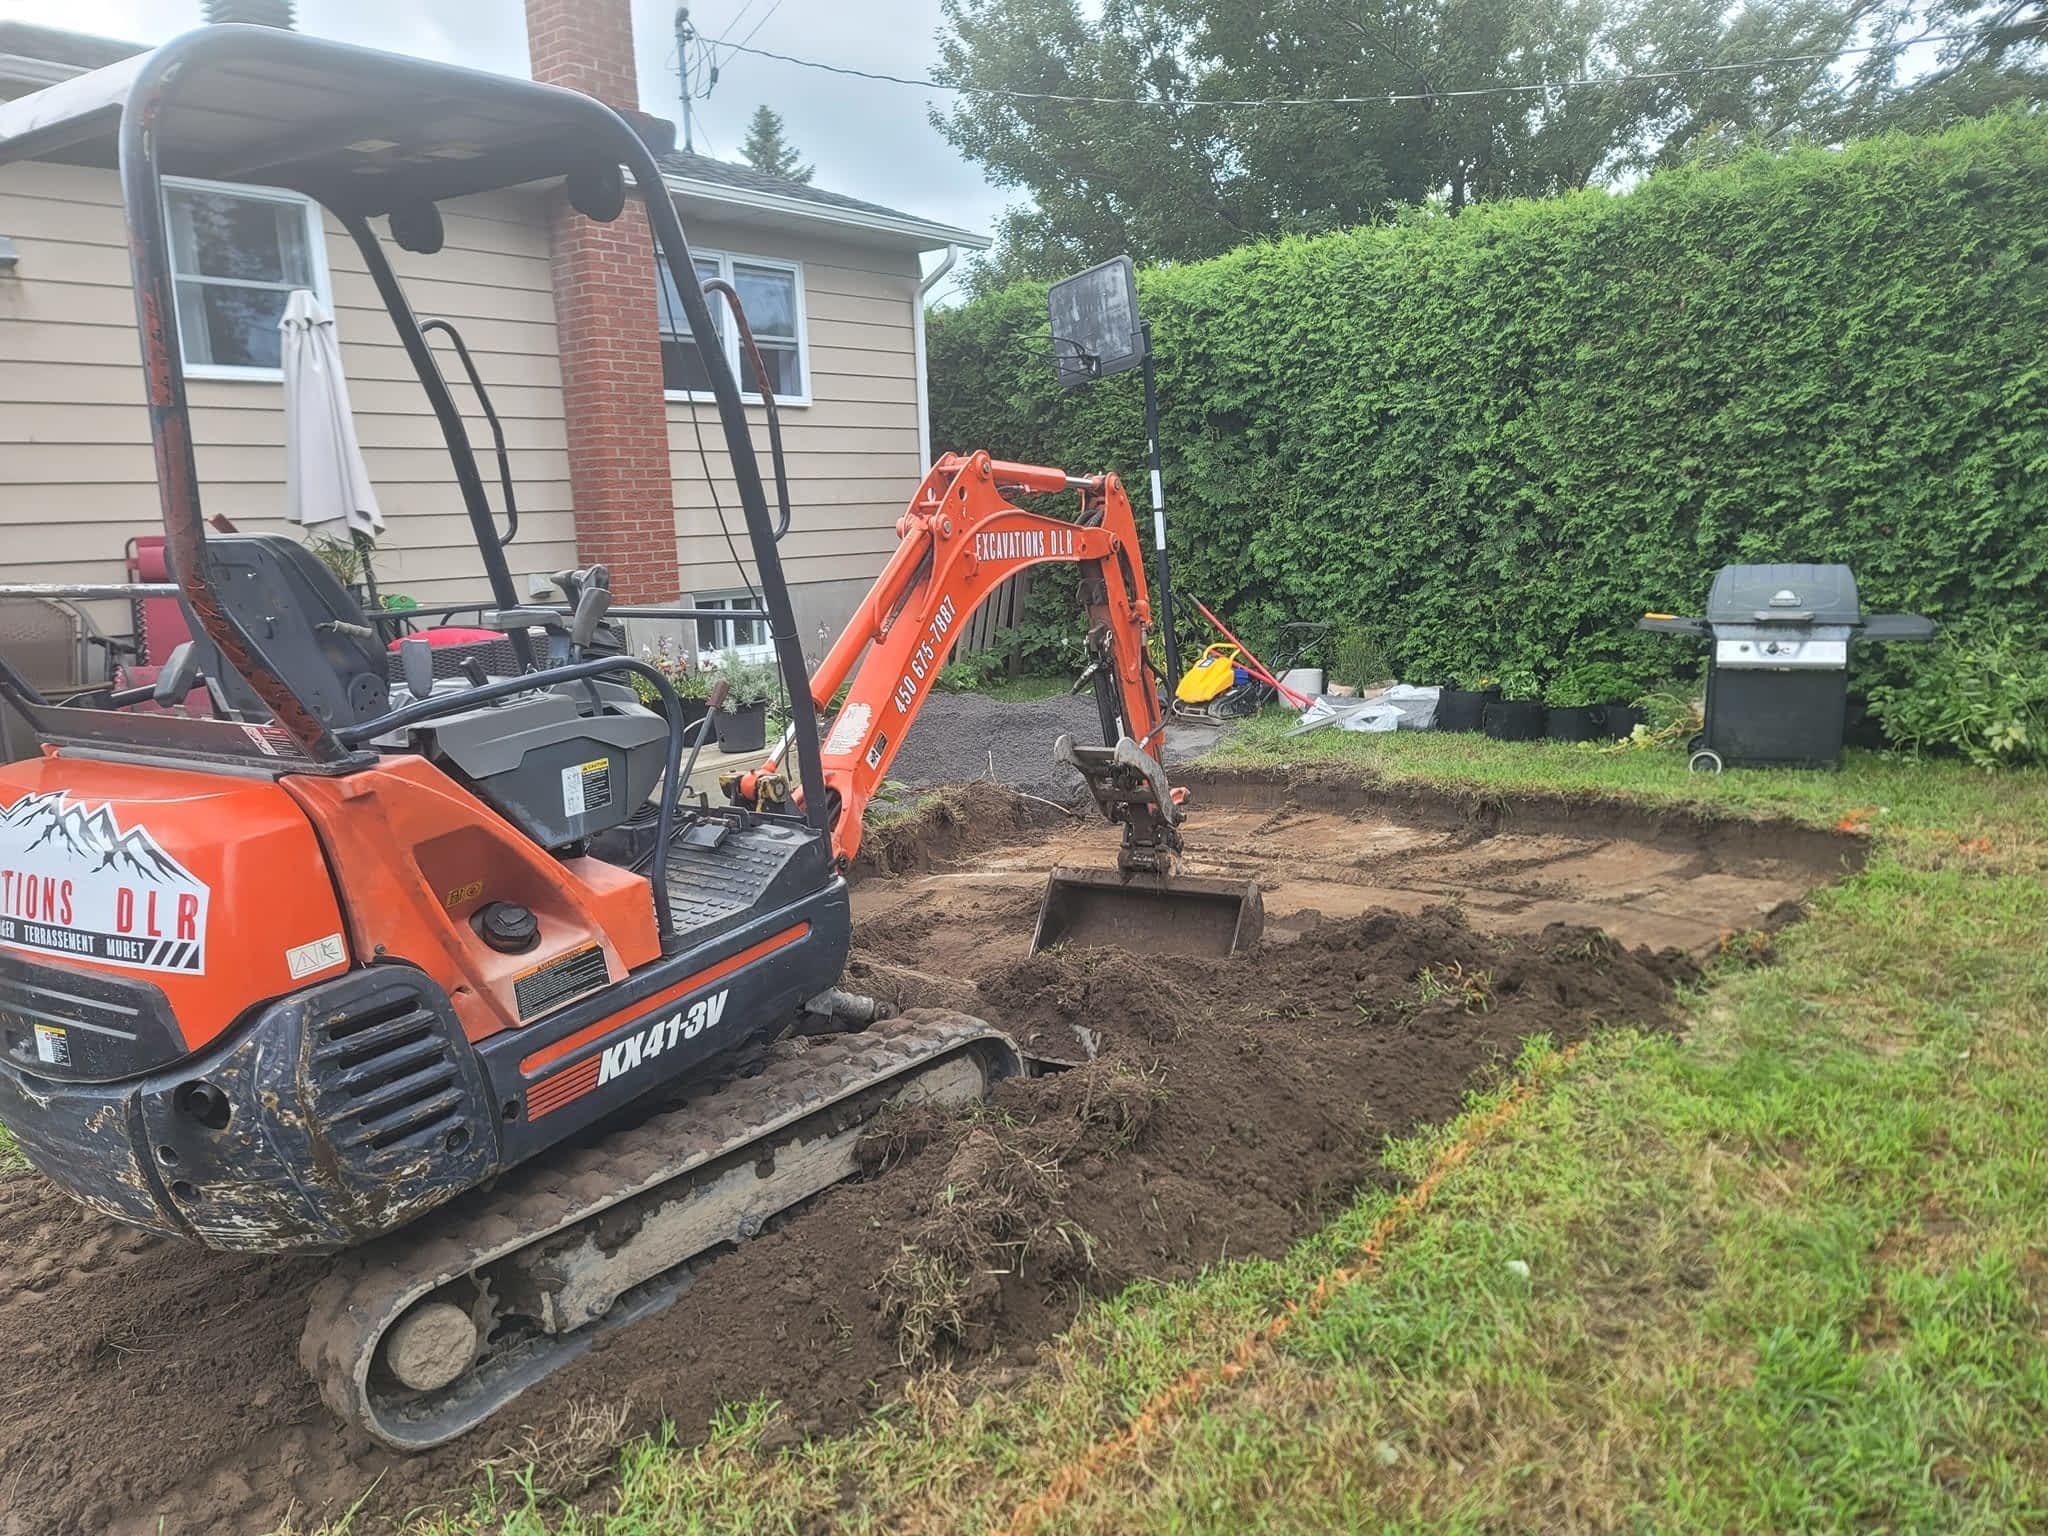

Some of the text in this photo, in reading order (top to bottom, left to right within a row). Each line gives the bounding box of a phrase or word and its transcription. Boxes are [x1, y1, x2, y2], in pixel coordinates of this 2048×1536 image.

[975, 529, 1073, 561] EXCAVATIONS DLR
[894, 594, 956, 713] 450 675-7887
[0, 869, 199, 941] TIONS DLR
[23, 924, 95, 953] TERRASSEMENT
[106, 938, 145, 960] MURET
[597, 989, 729, 1087] KX41-3V
